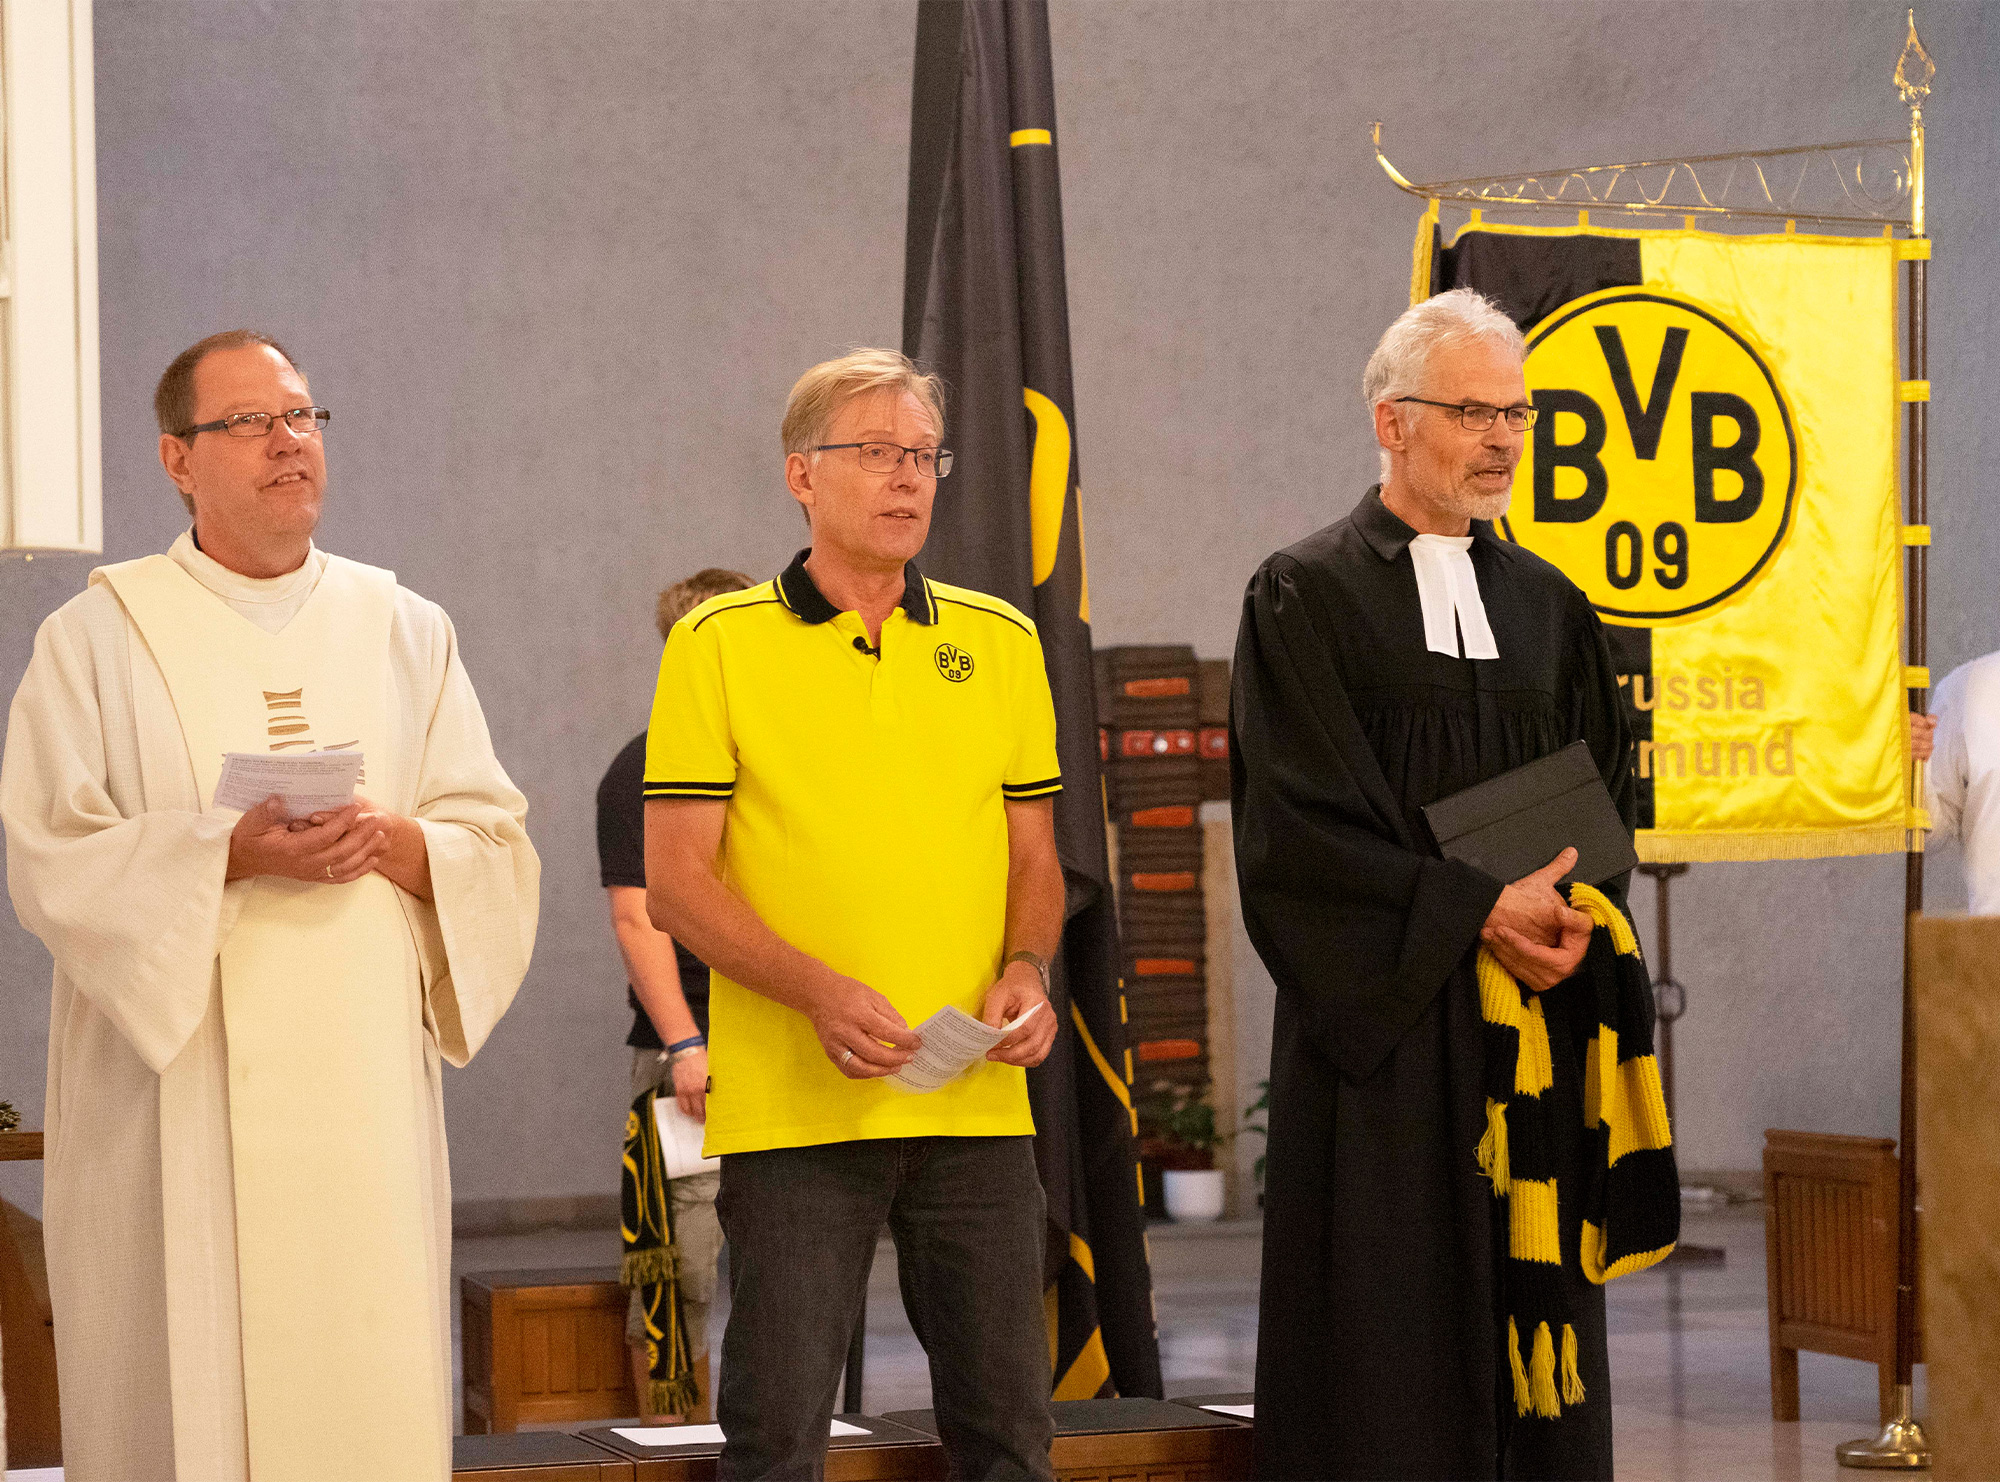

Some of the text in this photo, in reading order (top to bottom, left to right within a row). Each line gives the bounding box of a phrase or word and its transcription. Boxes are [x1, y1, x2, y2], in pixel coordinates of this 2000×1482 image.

[1532, 326, 1764, 523] BVB
[1606, 521, 1689, 590] 09
[939, 645, 971, 670] BVB
[949, 669, 961, 678] 09
[1631, 724, 1795, 779] mund
